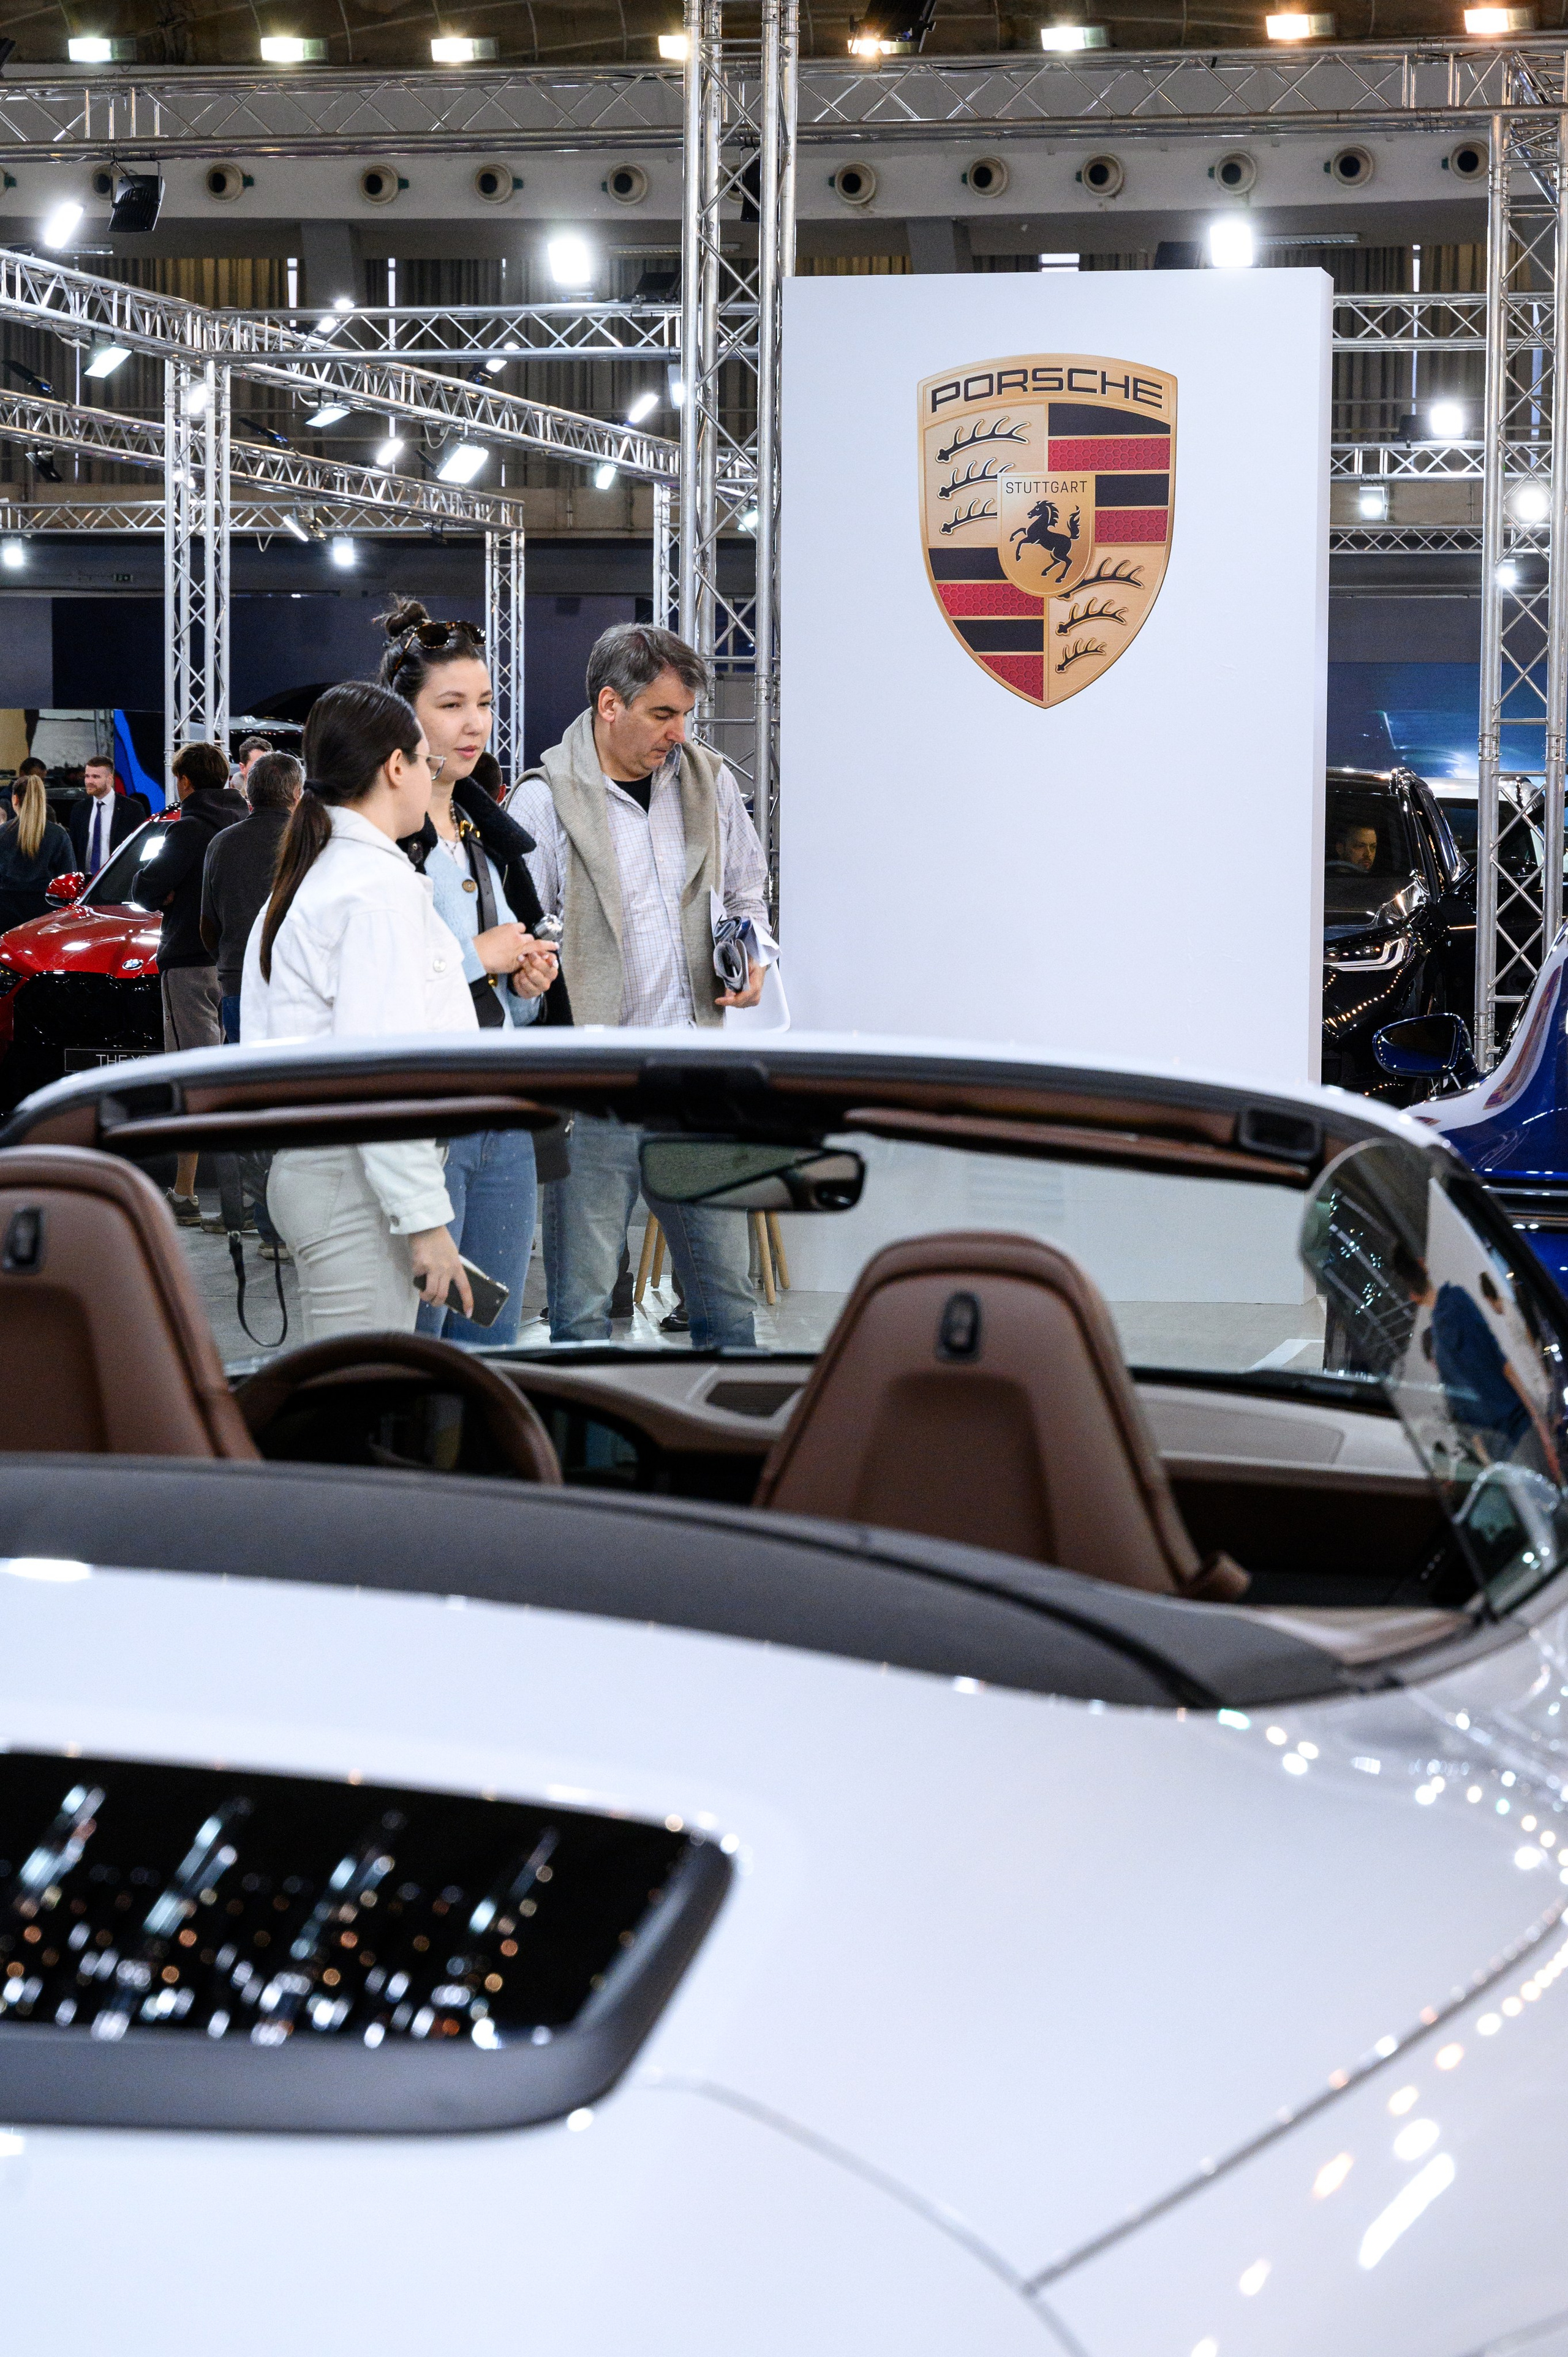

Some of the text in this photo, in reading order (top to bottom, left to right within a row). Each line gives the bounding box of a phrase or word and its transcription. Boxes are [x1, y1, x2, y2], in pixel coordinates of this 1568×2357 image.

[931, 367, 1163, 413] PORSCHE
[1006, 481, 1087, 494] STUTTGART
[96, 1054, 127, 1068] THE
